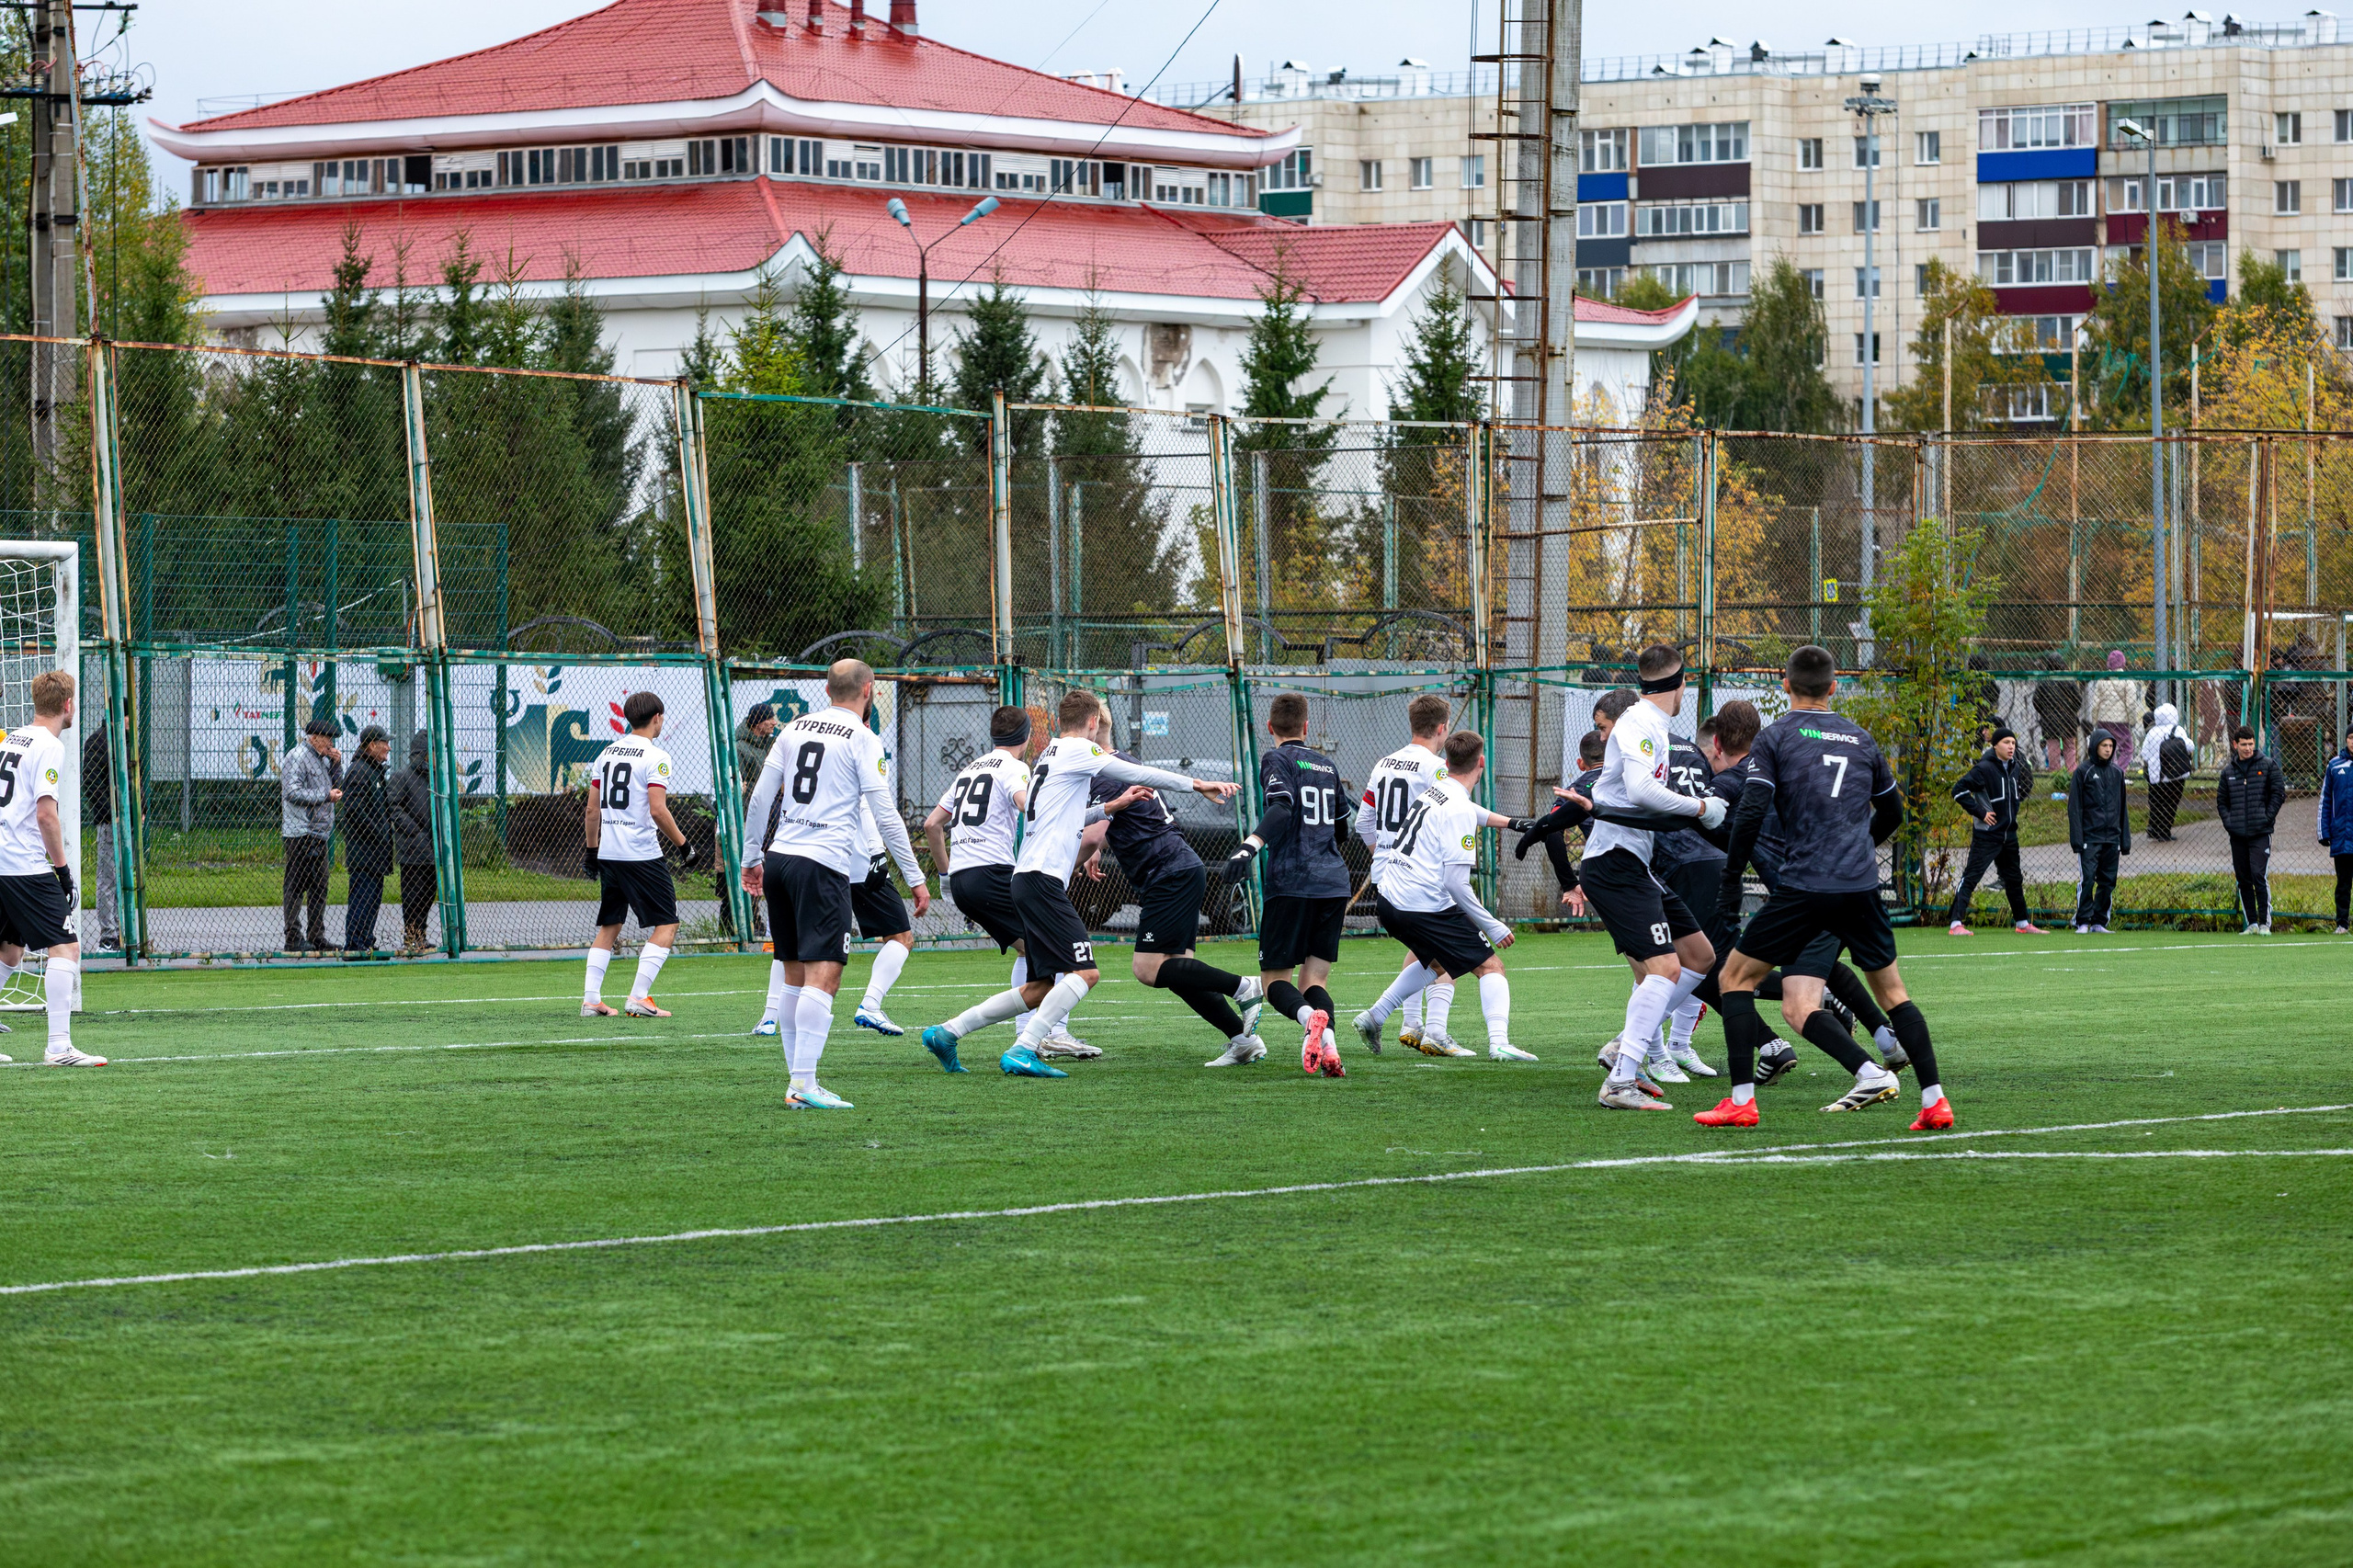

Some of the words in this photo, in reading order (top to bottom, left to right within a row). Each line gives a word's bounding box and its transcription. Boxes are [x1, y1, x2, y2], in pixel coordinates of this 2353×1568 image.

[794, 720, 854, 739] ТУРБИНА
[1798, 728, 1859, 745] VINSERVICE
[0, 750, 23, 808] 5
[600, 761, 632, 810] 18
[792, 741, 825, 805] 8
[1823, 754, 1848, 798] 7
[1301, 785, 1335, 825] 90
[1376, 776, 1409, 832] 10
[805, 820, 828, 829] Гарант
[1391, 799, 1431, 857] 91
[843, 932, 851, 954] 8
[1073, 941, 1094, 962] 27
[1650, 922, 1672, 945] 87
